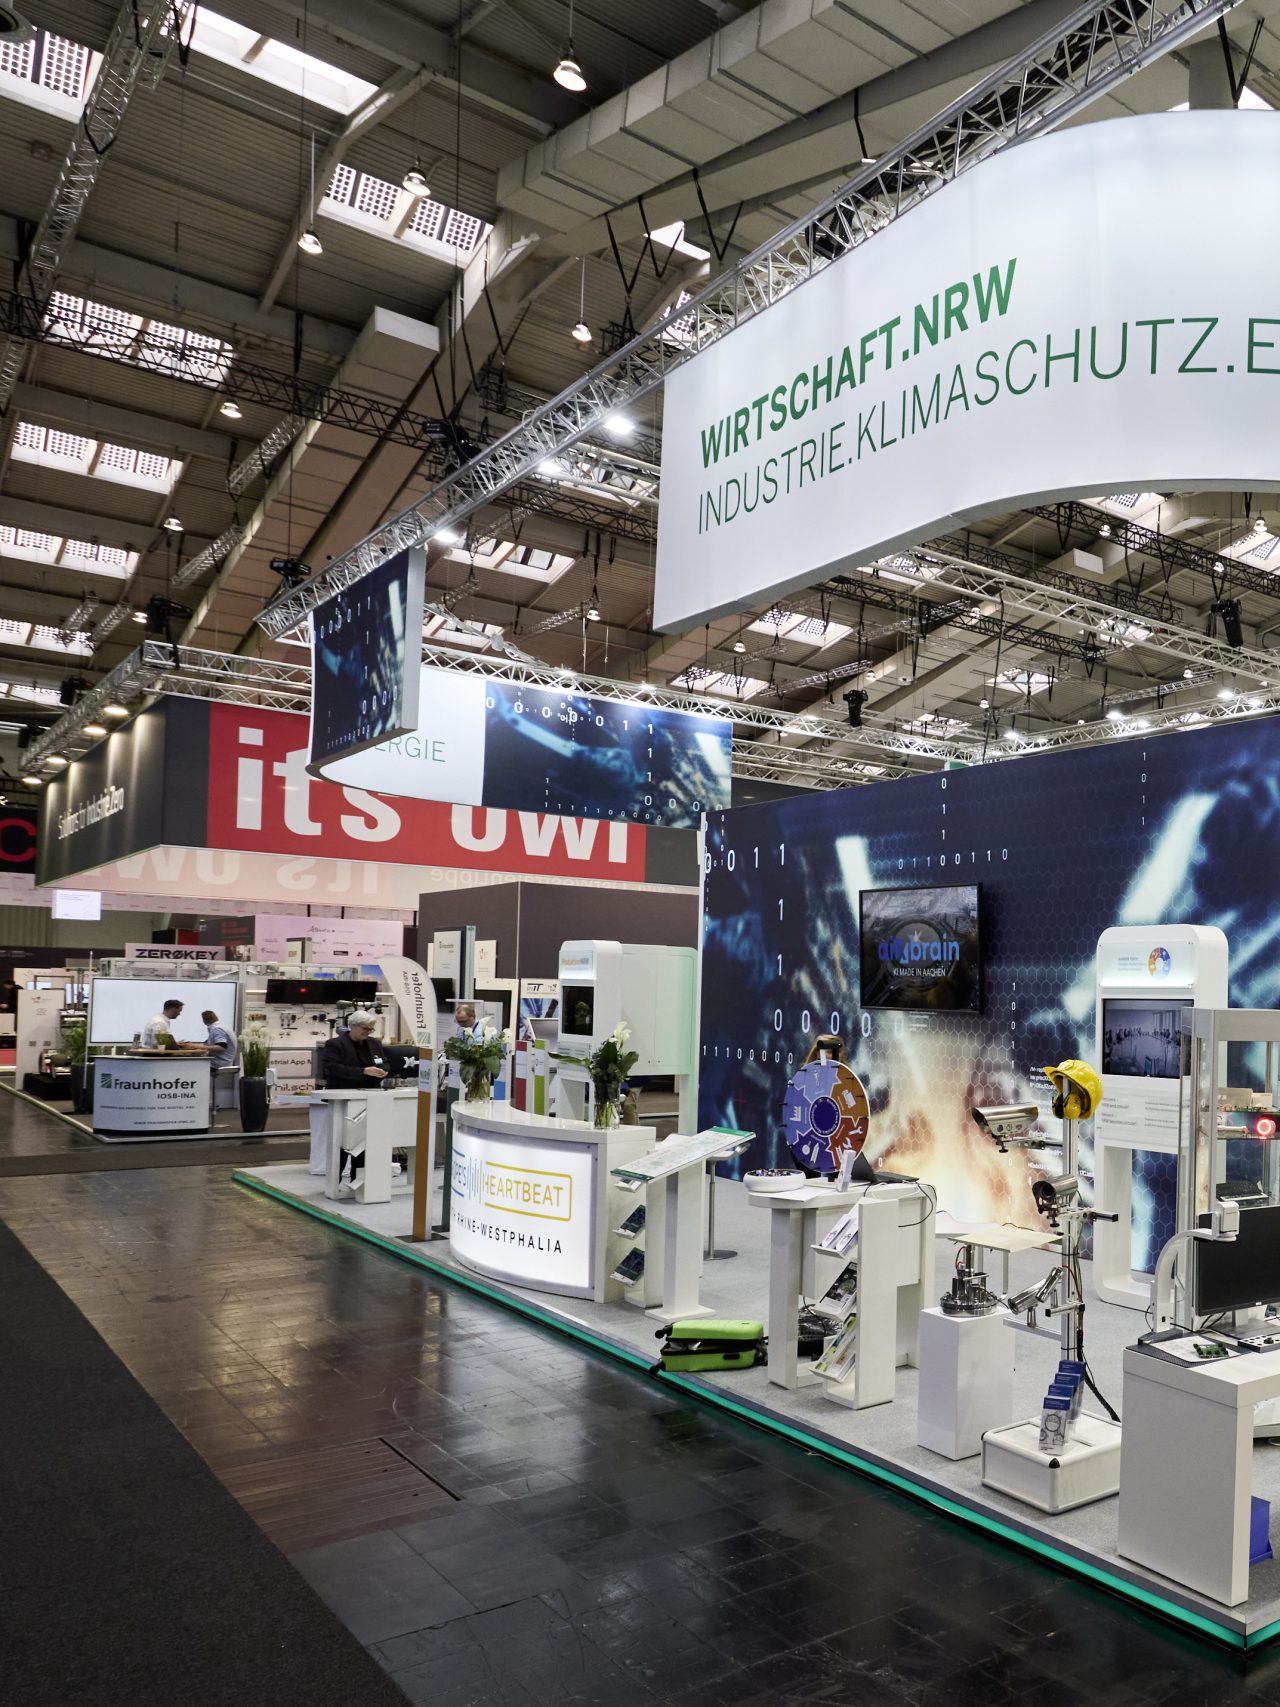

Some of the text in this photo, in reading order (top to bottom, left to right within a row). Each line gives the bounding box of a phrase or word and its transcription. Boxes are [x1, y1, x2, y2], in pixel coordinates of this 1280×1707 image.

[700, 257, 1017, 469] WIRTSCHAFT.NRW
[900, 967, 915, 976] MADE
[915, 967, 922, 976] IN
[922, 967, 946, 977] AACHEN
[113, 1077, 198, 1091] Fraunhofer
[485, 1174, 564, 1207] HEARTBEAT
